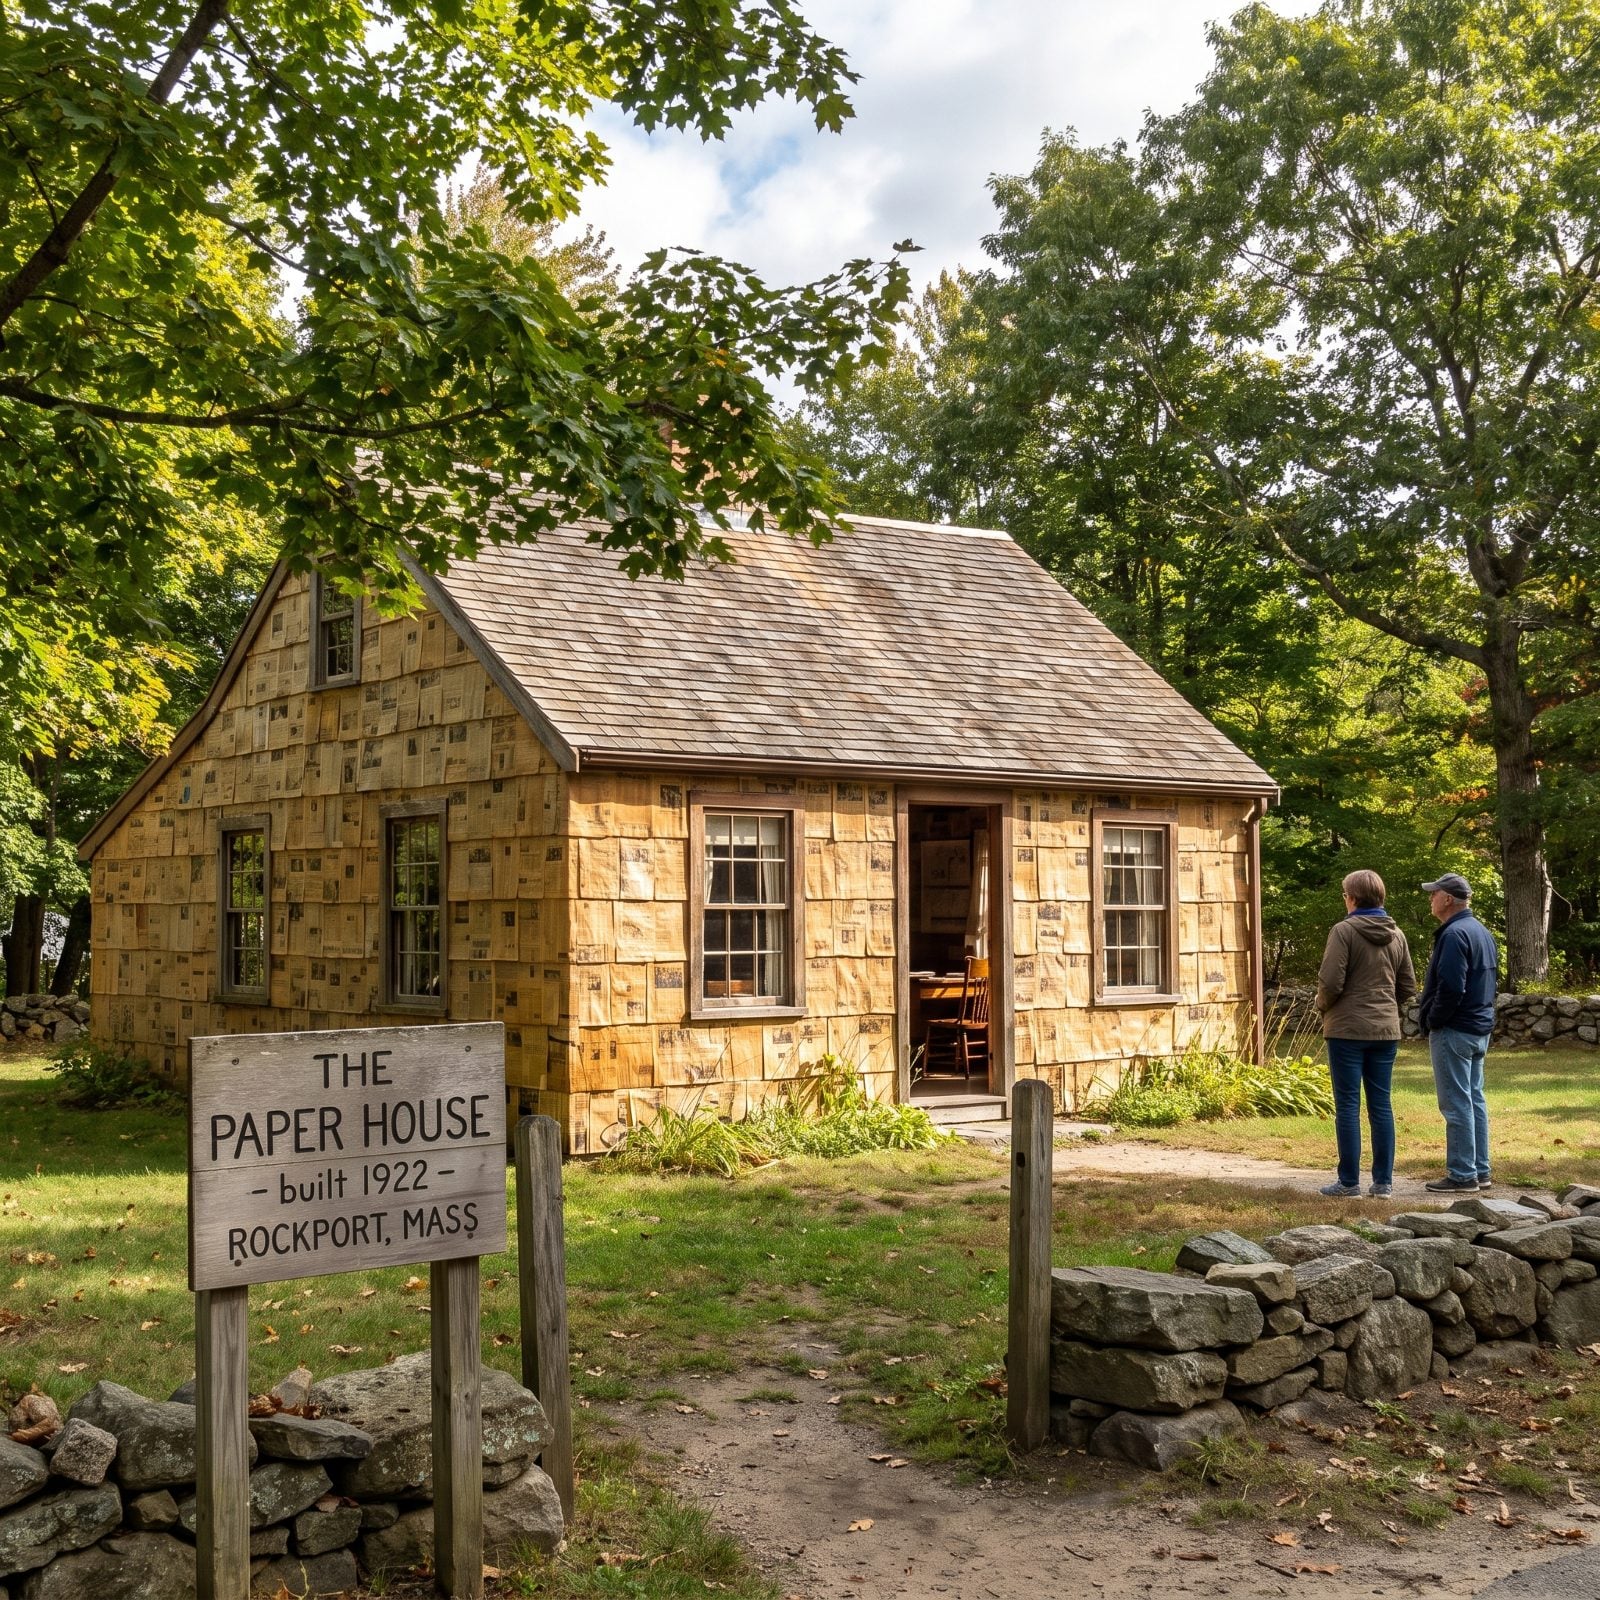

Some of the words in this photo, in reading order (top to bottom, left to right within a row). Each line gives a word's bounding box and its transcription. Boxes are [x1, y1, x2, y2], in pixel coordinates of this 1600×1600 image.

[313, 1050, 393, 1089] THE
[210, 1105, 344, 1162] PAPER
[363, 1094, 491, 1148] HOUSE
[280, 1167, 348, 1205] built
[363, 1159, 429, 1196] 1922
[228, 1211, 392, 1260] ROCKPORT,
